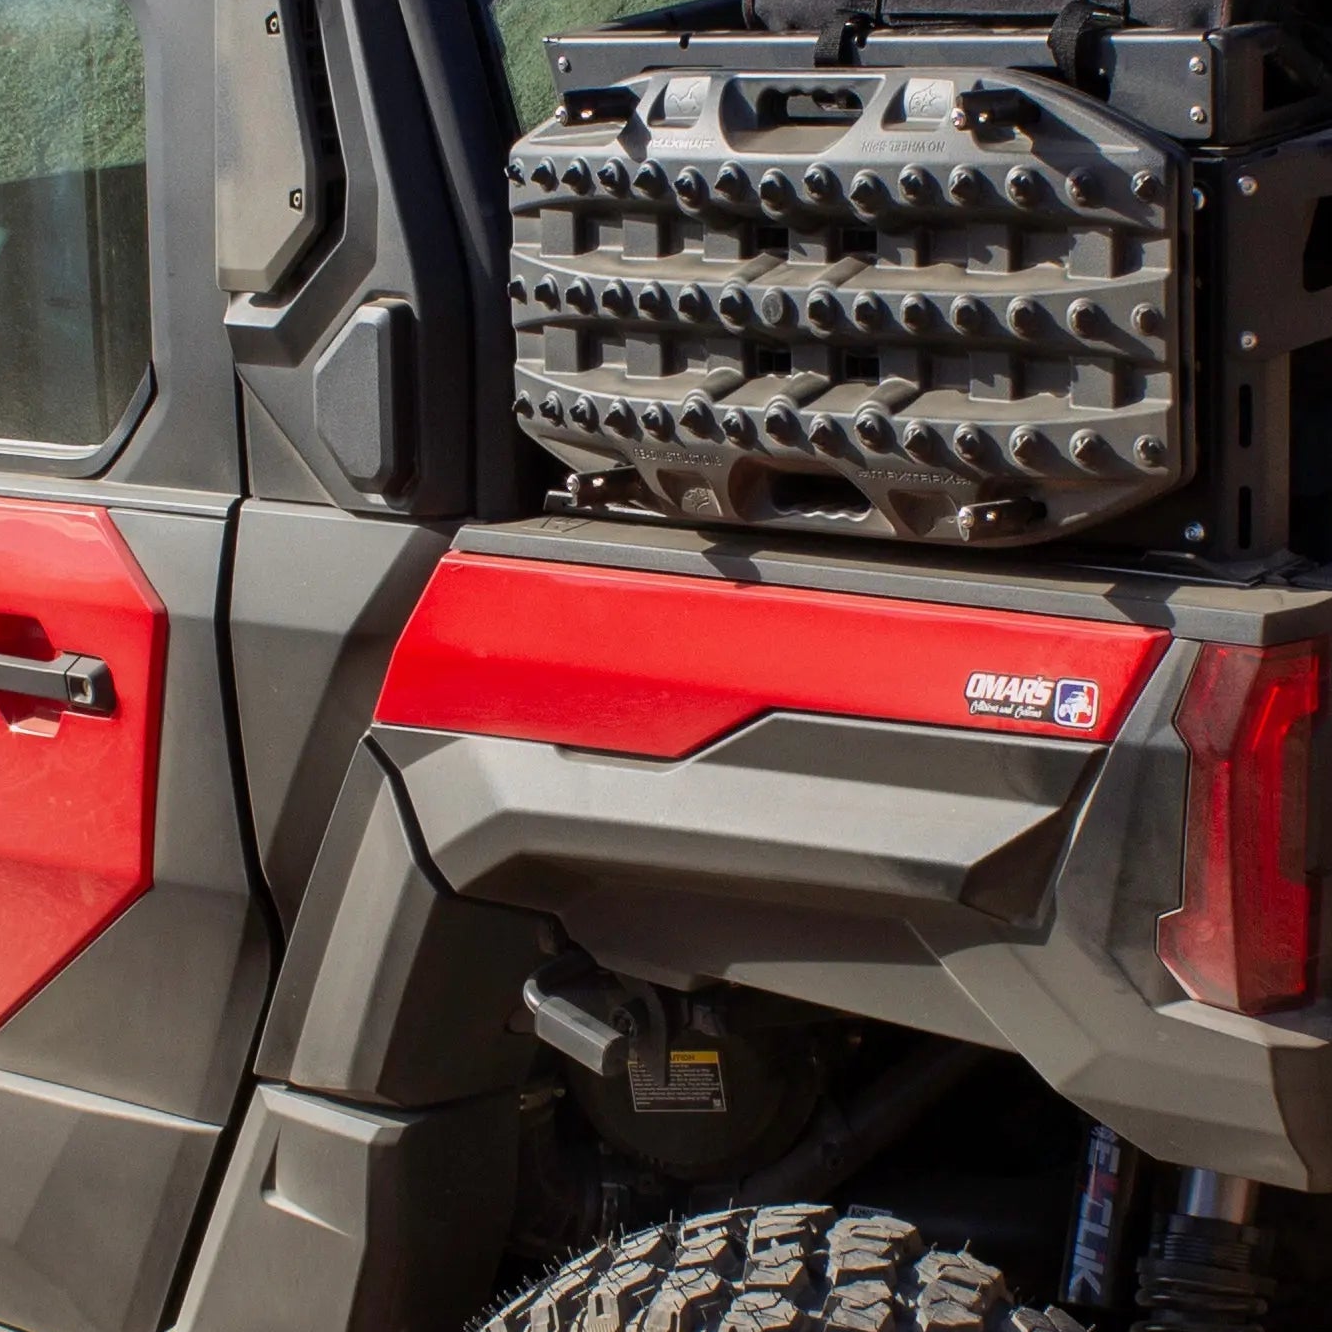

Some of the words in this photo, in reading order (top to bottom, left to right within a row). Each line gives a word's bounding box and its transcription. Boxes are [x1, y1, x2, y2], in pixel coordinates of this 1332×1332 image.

[861, 141, 887, 152] SPIN
[889, 141, 927, 152] WHEEL
[928, 141, 945, 152] NO
[965, 672, 1056, 706] OMAR'S
